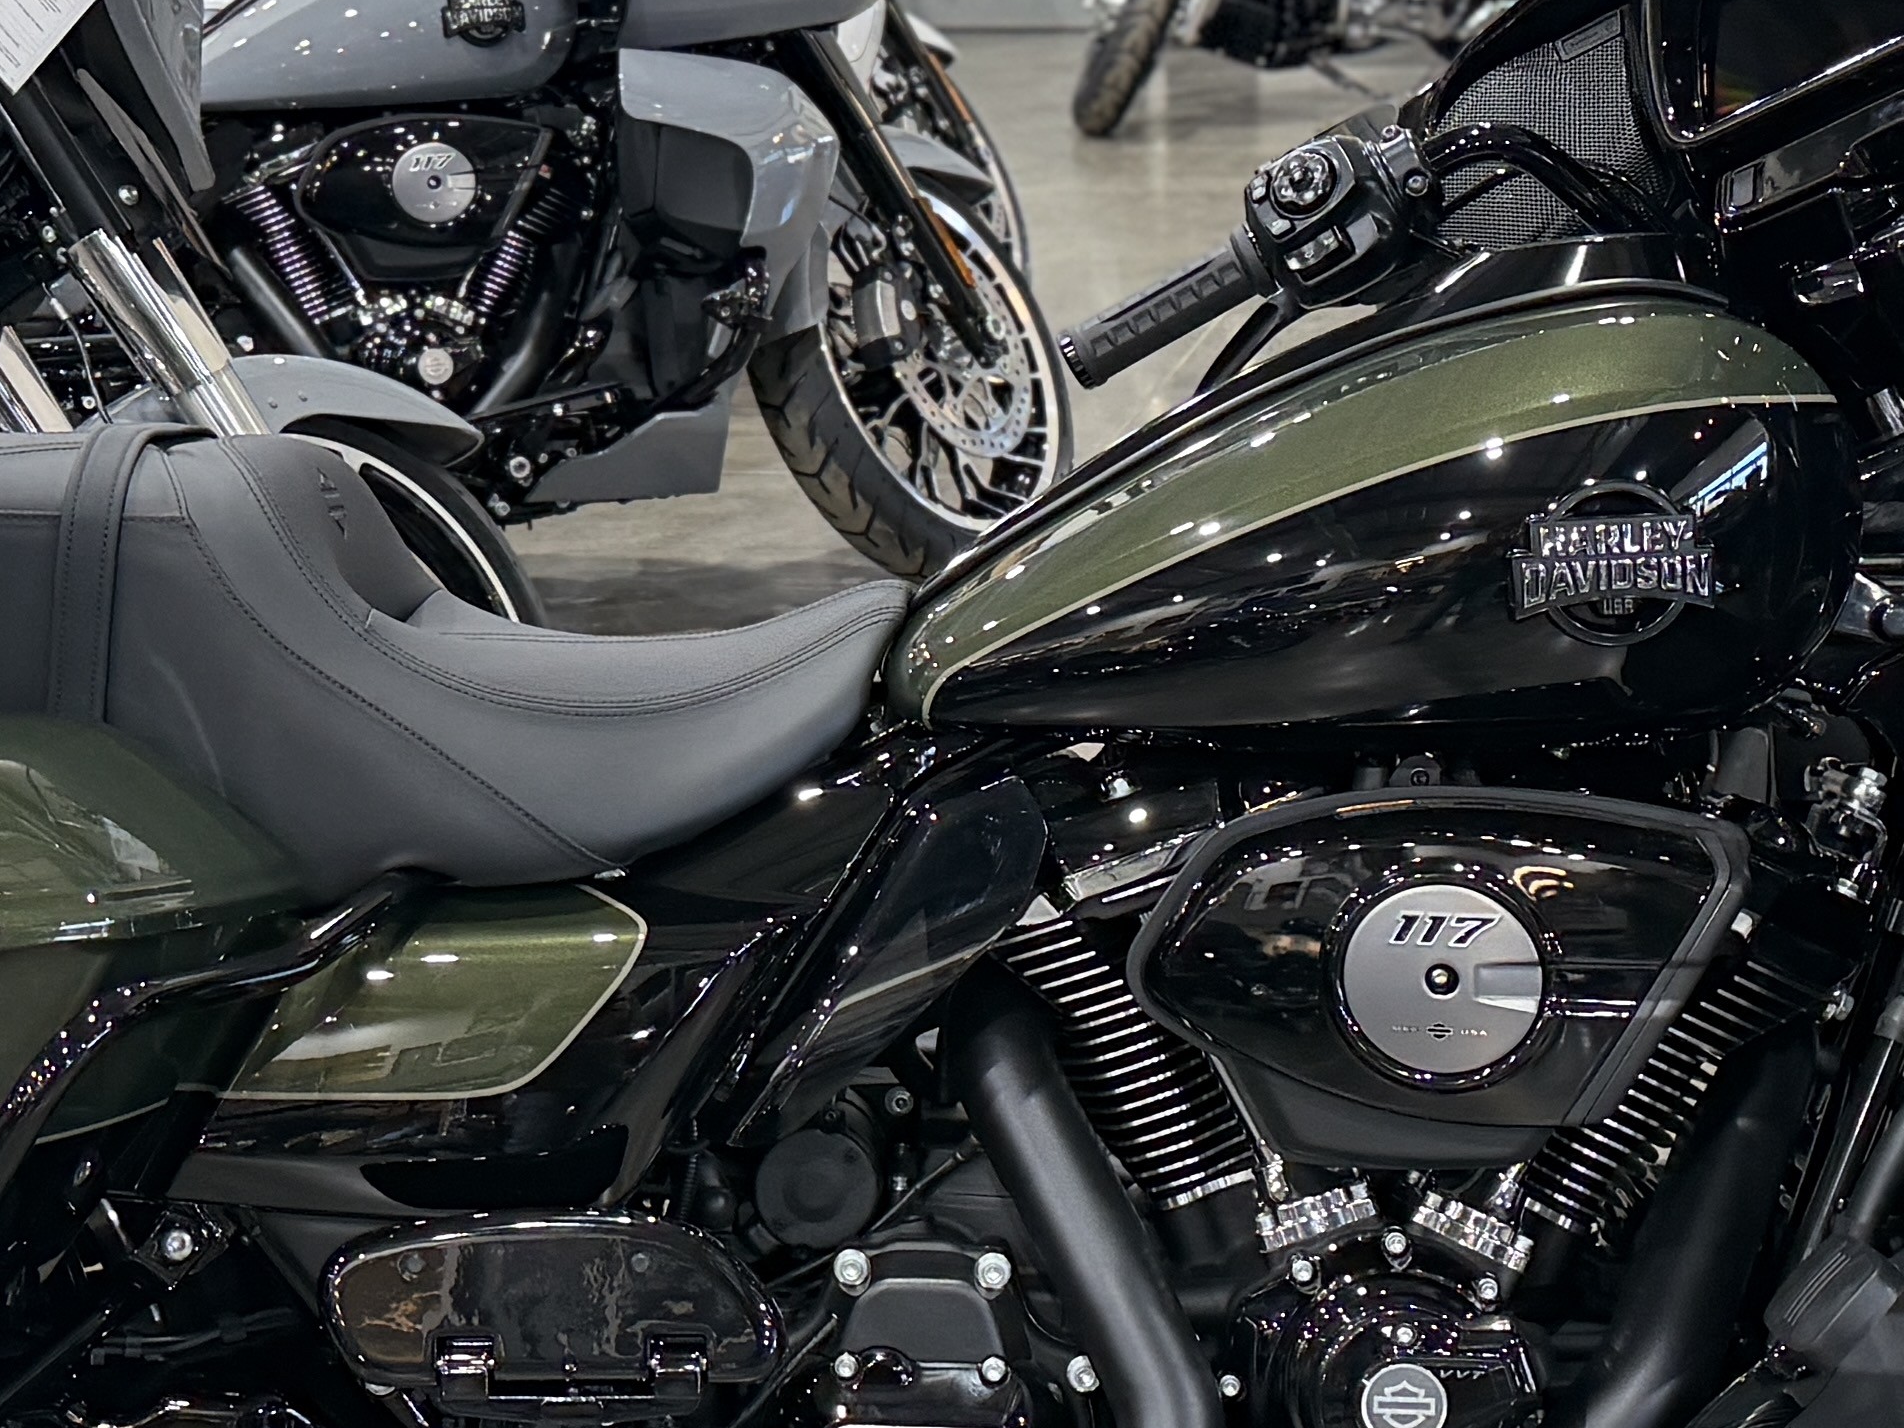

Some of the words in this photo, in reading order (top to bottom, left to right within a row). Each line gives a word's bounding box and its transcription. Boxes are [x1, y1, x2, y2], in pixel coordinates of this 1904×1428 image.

[409, 152, 456, 172] 117
[1522, 552, 1711, 609] DAVIDSON
[1388, 910, 1502, 948] 117
[1460, 1028, 1488, 1037] USA
[1440, 1369, 1486, 1380] VVT
